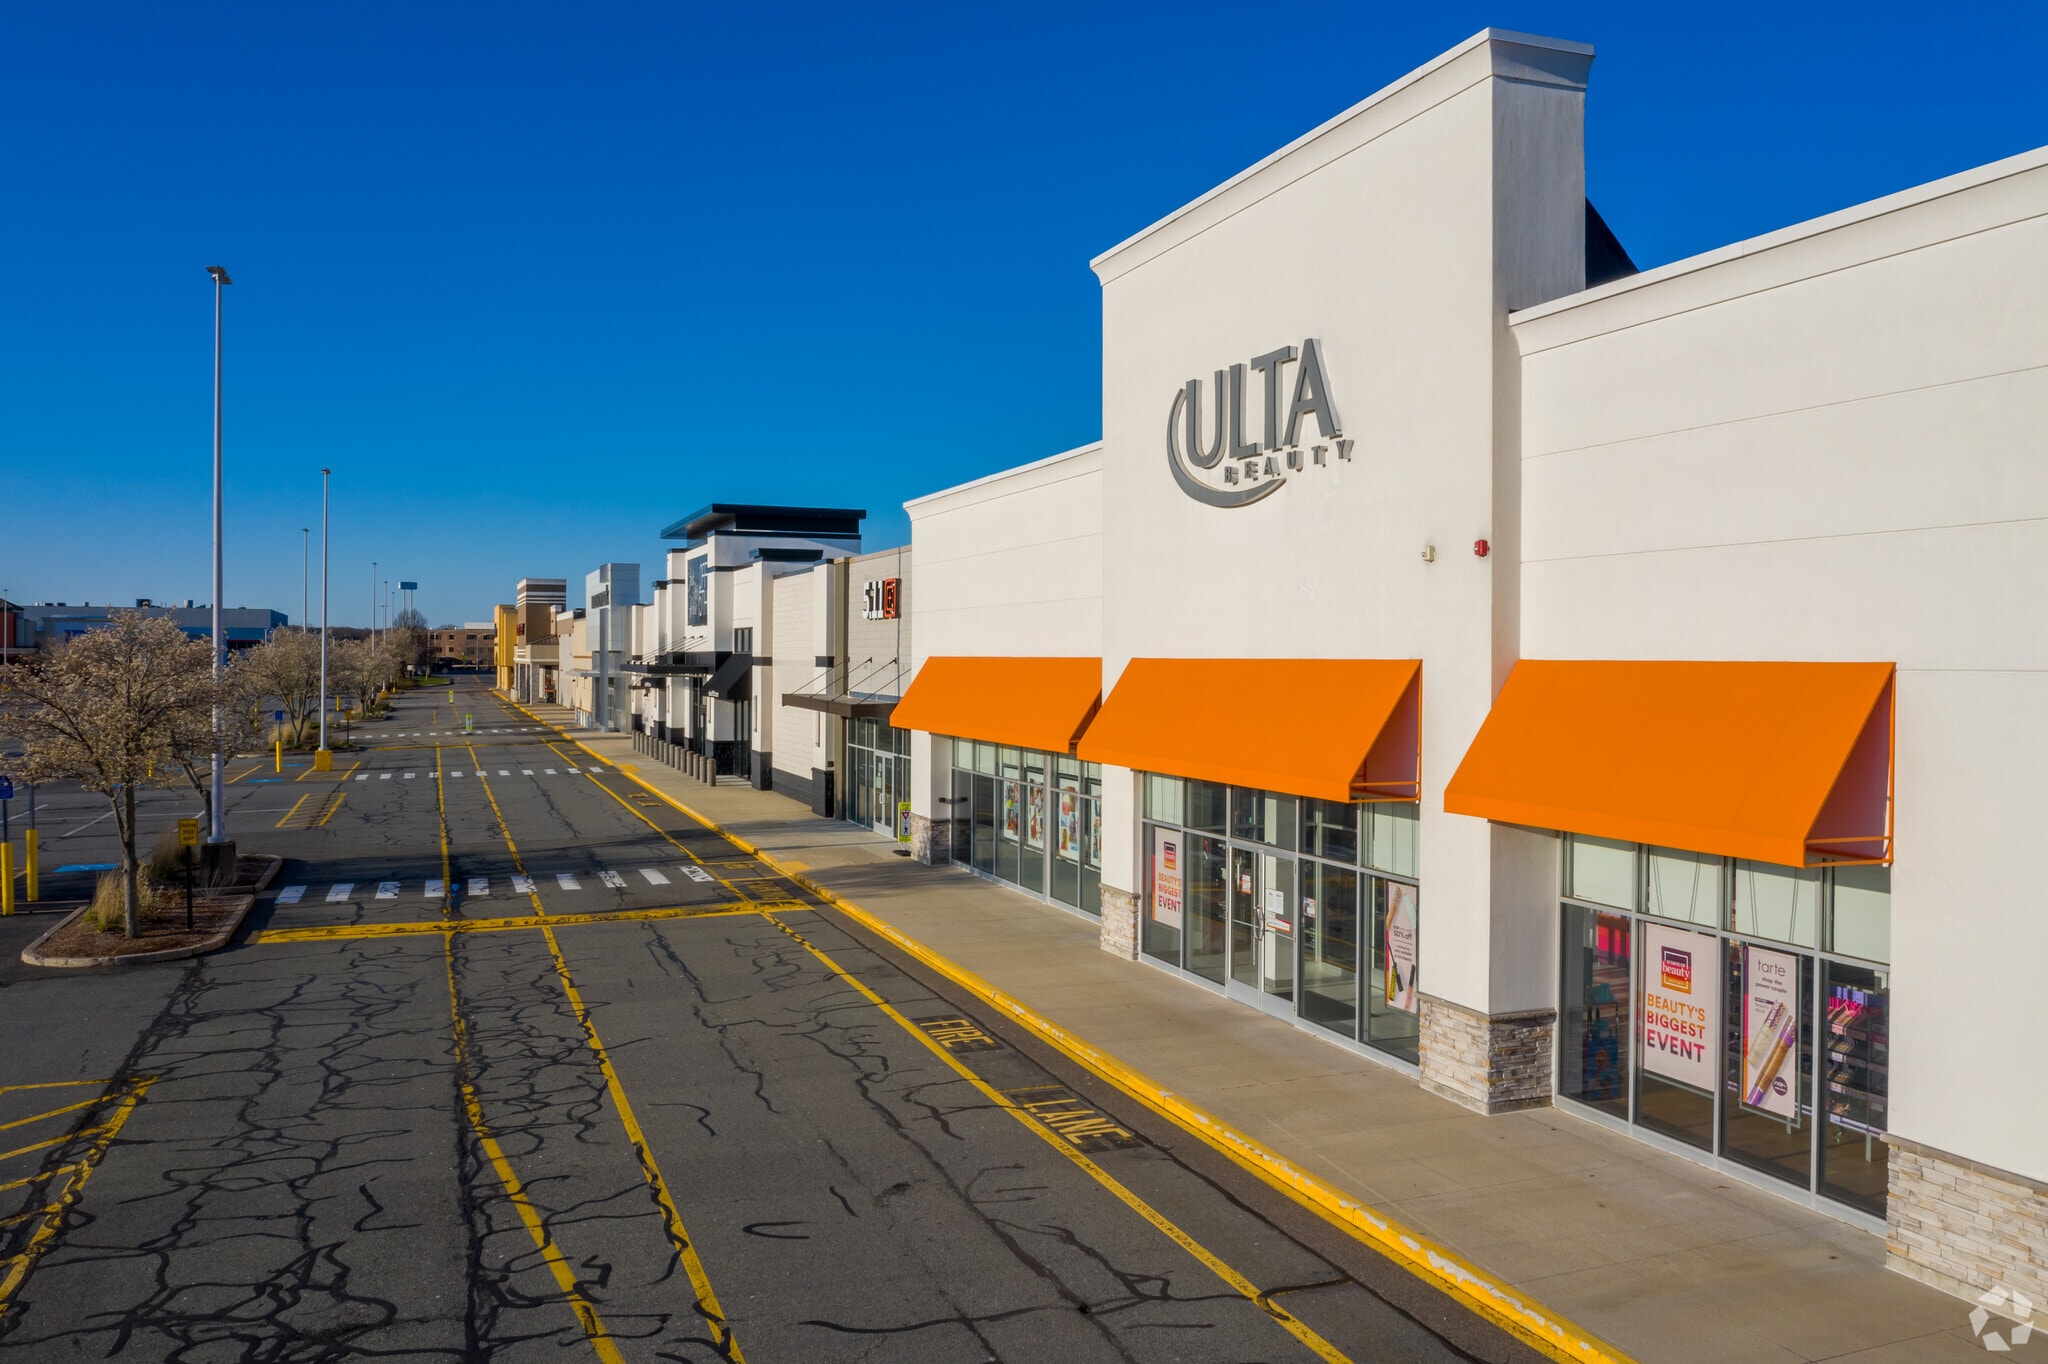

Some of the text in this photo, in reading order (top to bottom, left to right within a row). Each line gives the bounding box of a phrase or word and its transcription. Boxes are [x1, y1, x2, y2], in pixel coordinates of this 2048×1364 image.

[1186, 338, 1343, 469] ULTA
[1224, 439, 1355, 486] BEAUTY
[1158, 873, 1182, 887] BEAUTY'S
[1158, 883, 1181, 898] BIGGEST
[1158, 895, 1181, 913] EVENT
[1662, 961, 1690, 980] beauty
[1757, 959, 1785, 977] tarte
[1647, 992, 1706, 1021] BEAUTY'S
[920, 1018, 996, 1048] FIRE
[1647, 1010, 1705, 1039] BIGGEST
[1647, 1029, 1705, 1063] EVENT
[1022, 1098, 1133, 1144] LANE
